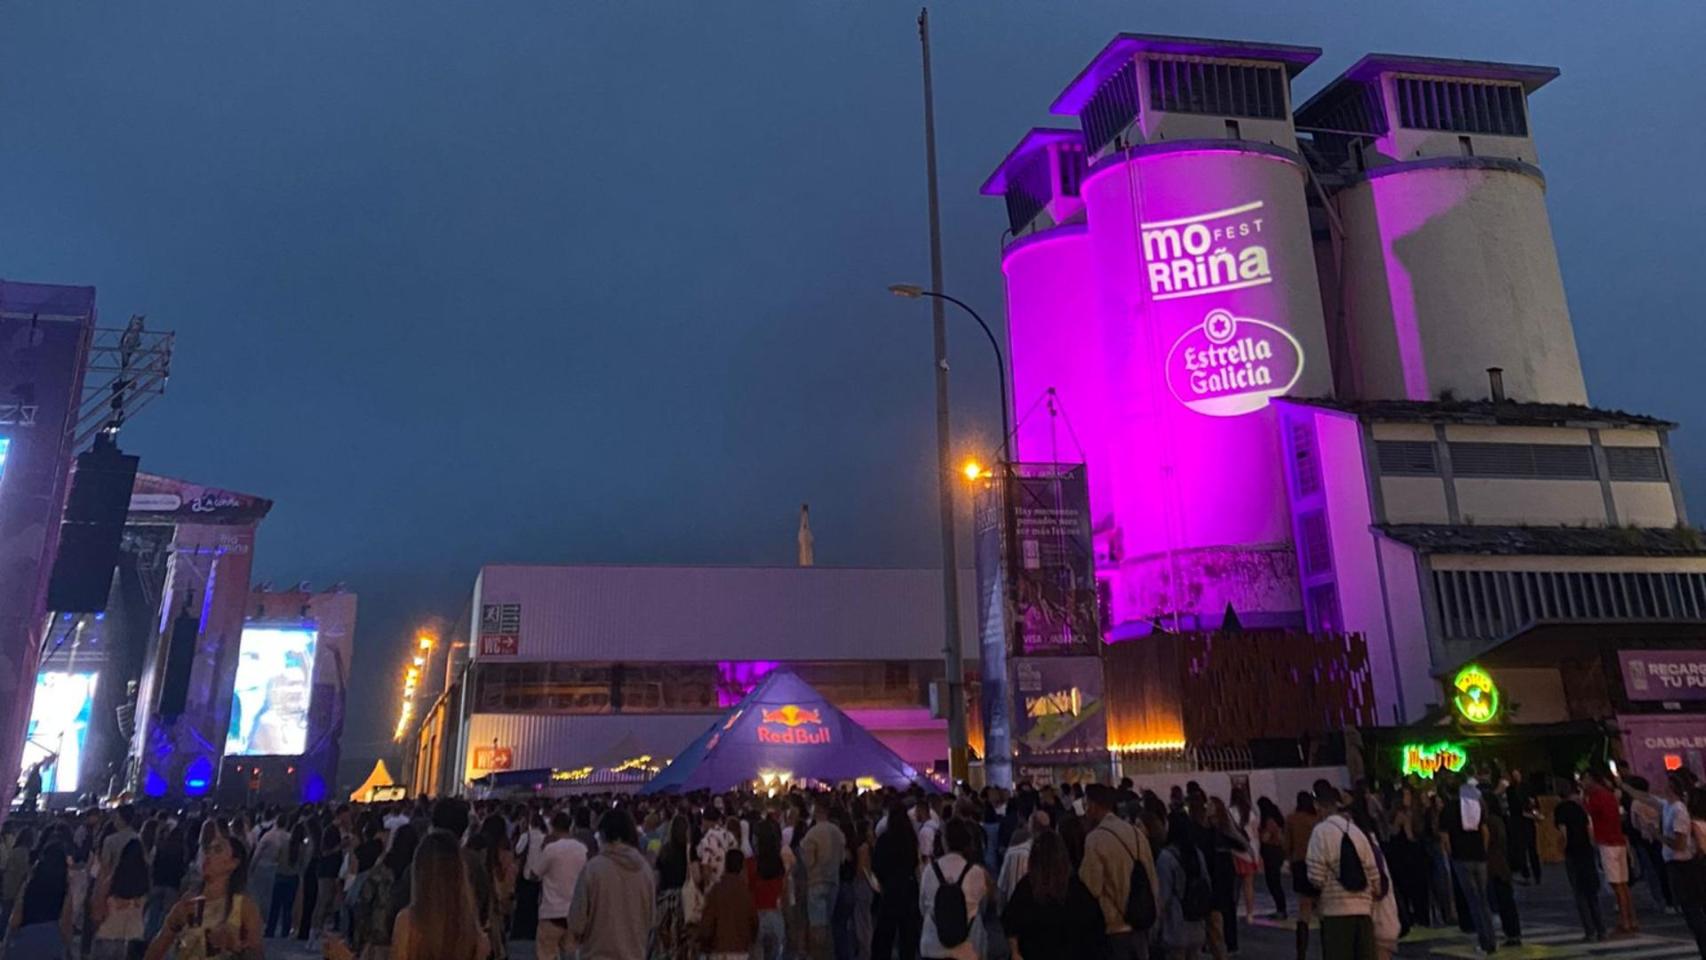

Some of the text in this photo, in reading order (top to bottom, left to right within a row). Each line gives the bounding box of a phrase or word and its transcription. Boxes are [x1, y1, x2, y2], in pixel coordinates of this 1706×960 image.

[1214, 219, 1264, 242] FEST
[1184, 337, 1273, 371] Estrella
[1190, 363, 1272, 395] Galicia
[484, 636, 501, 654] WC
[1660, 676, 1683, 688] TU
[757, 726, 831, 744] Red Bull
[1644, 736, 1706, 750] CASHLE
